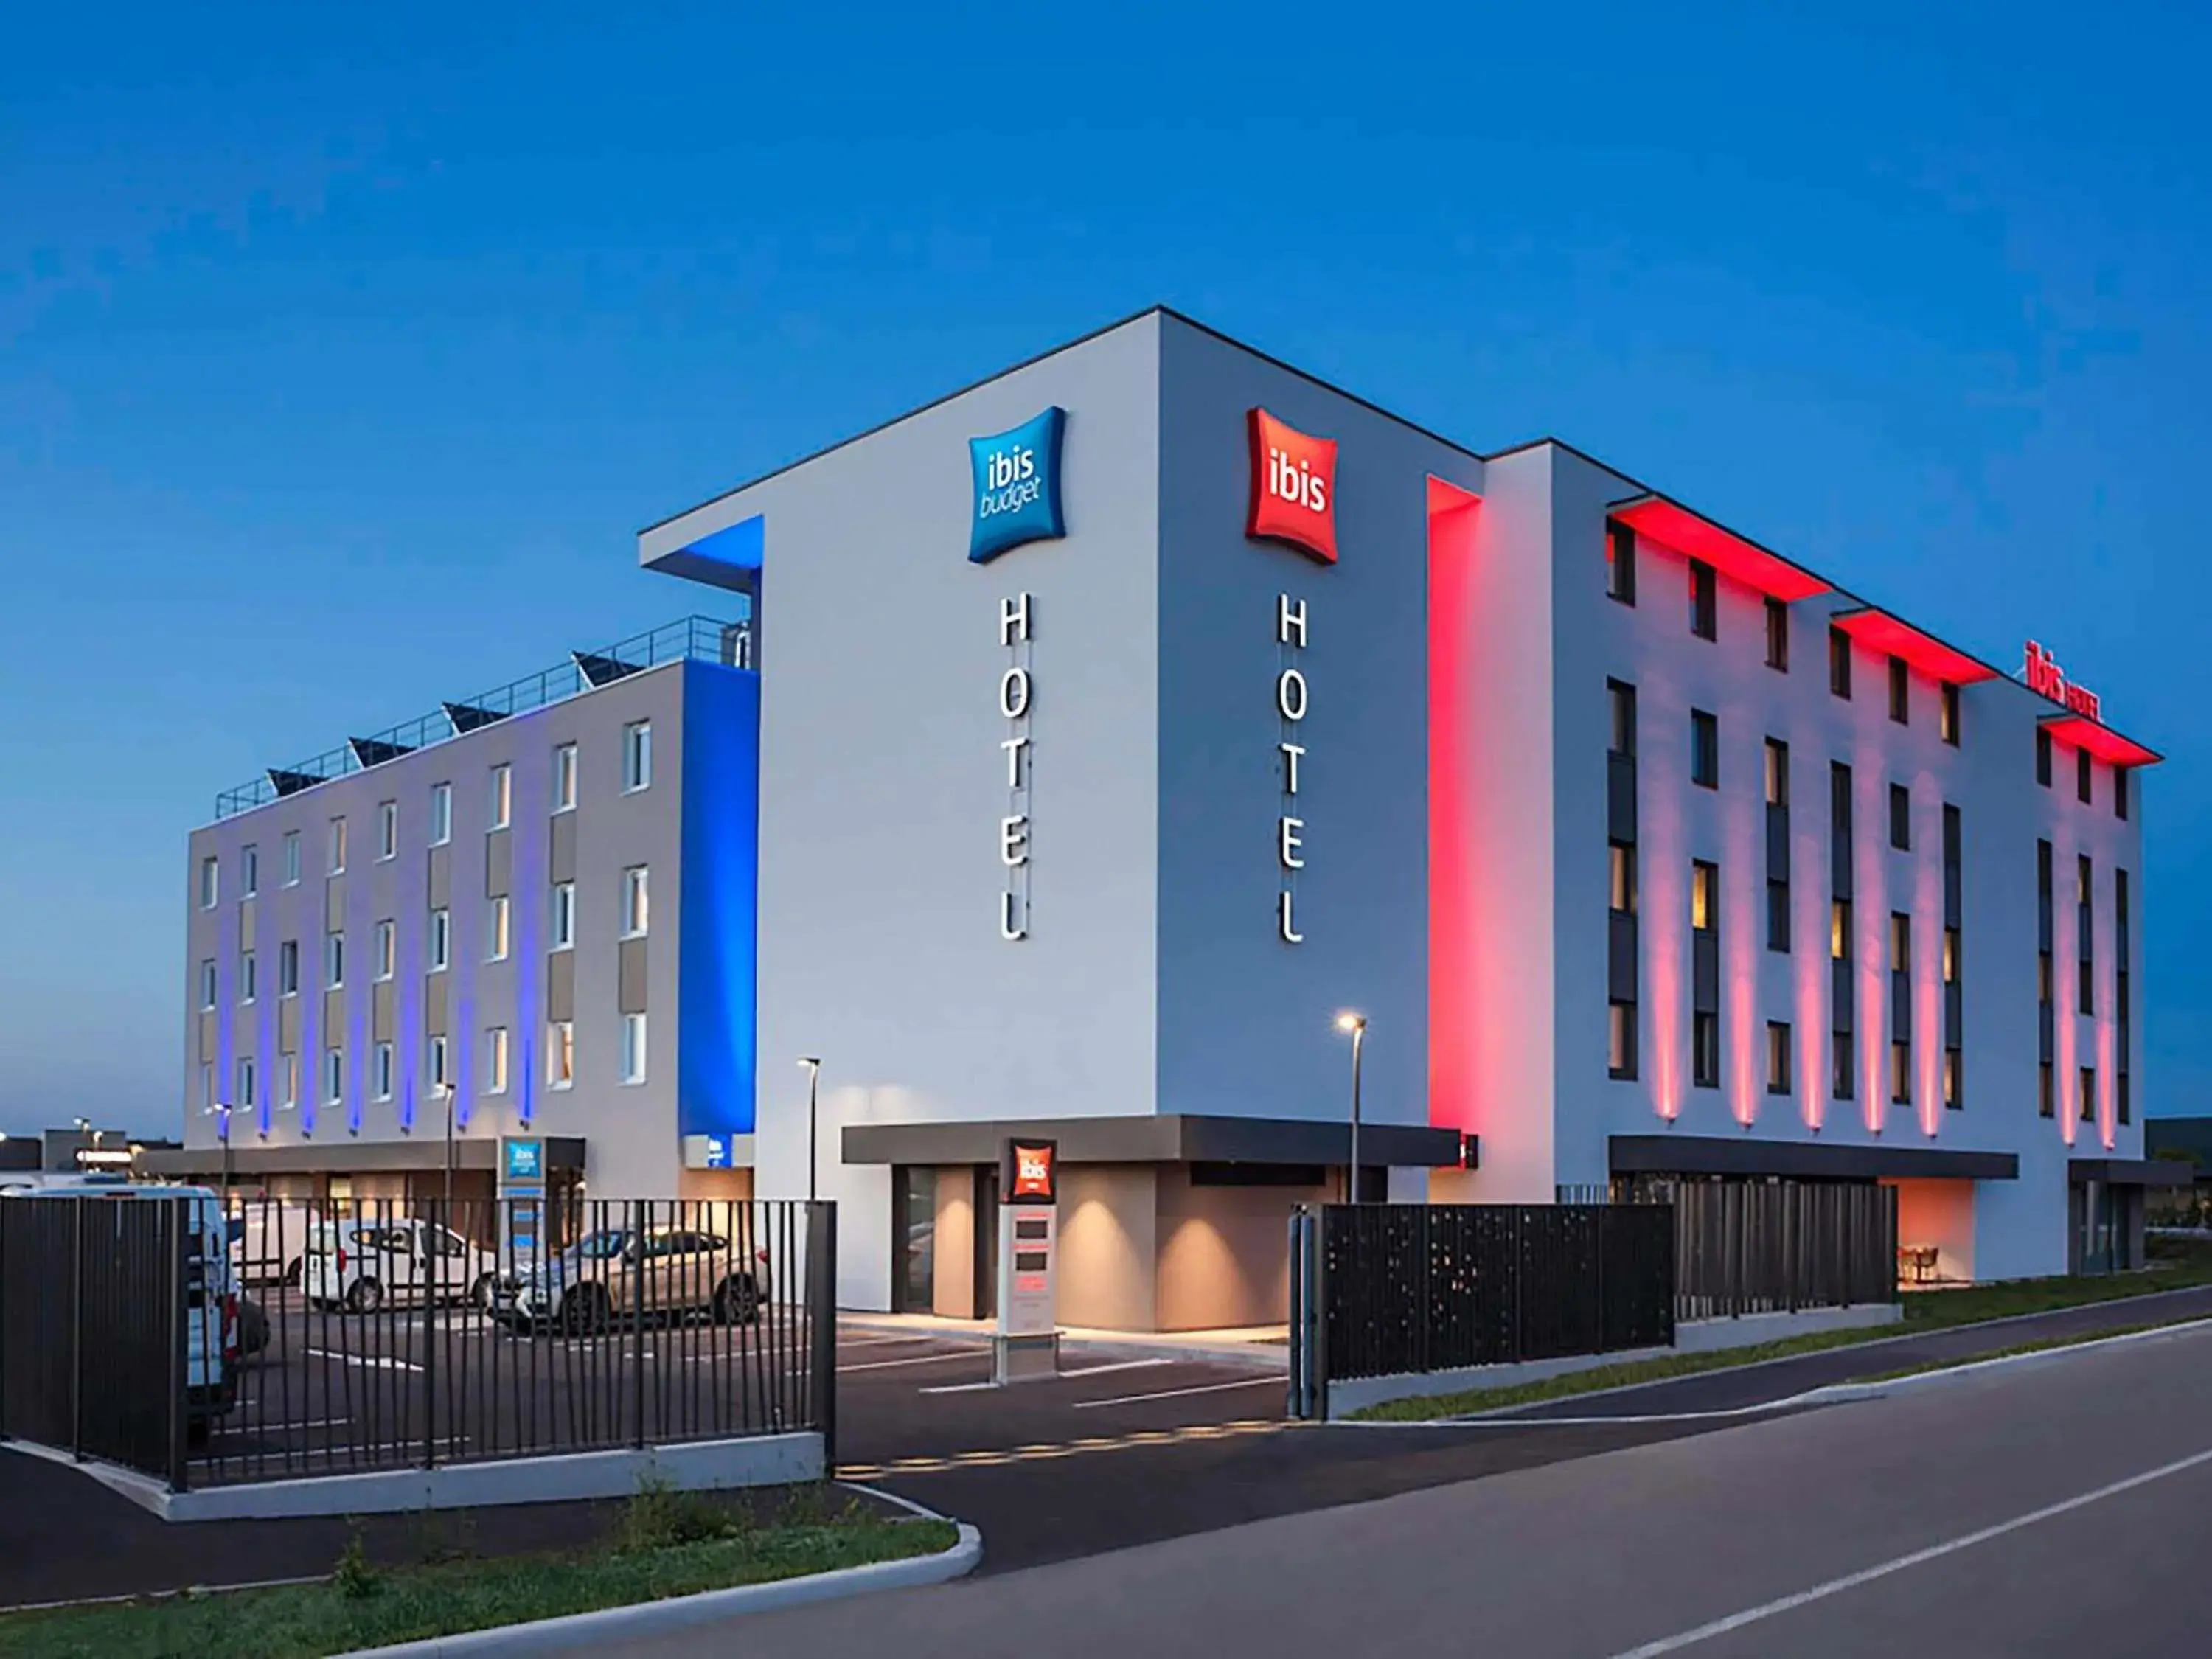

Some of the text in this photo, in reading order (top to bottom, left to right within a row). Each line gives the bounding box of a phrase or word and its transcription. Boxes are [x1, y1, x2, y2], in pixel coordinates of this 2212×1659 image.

[979, 476, 1041, 518] budget
[989, 445, 1034, 490] ibis
[1270, 447, 1326, 512] ibis
[1000, 592, 1031, 941] HOTEL
[1279, 593, 1307, 943] HOTEL
